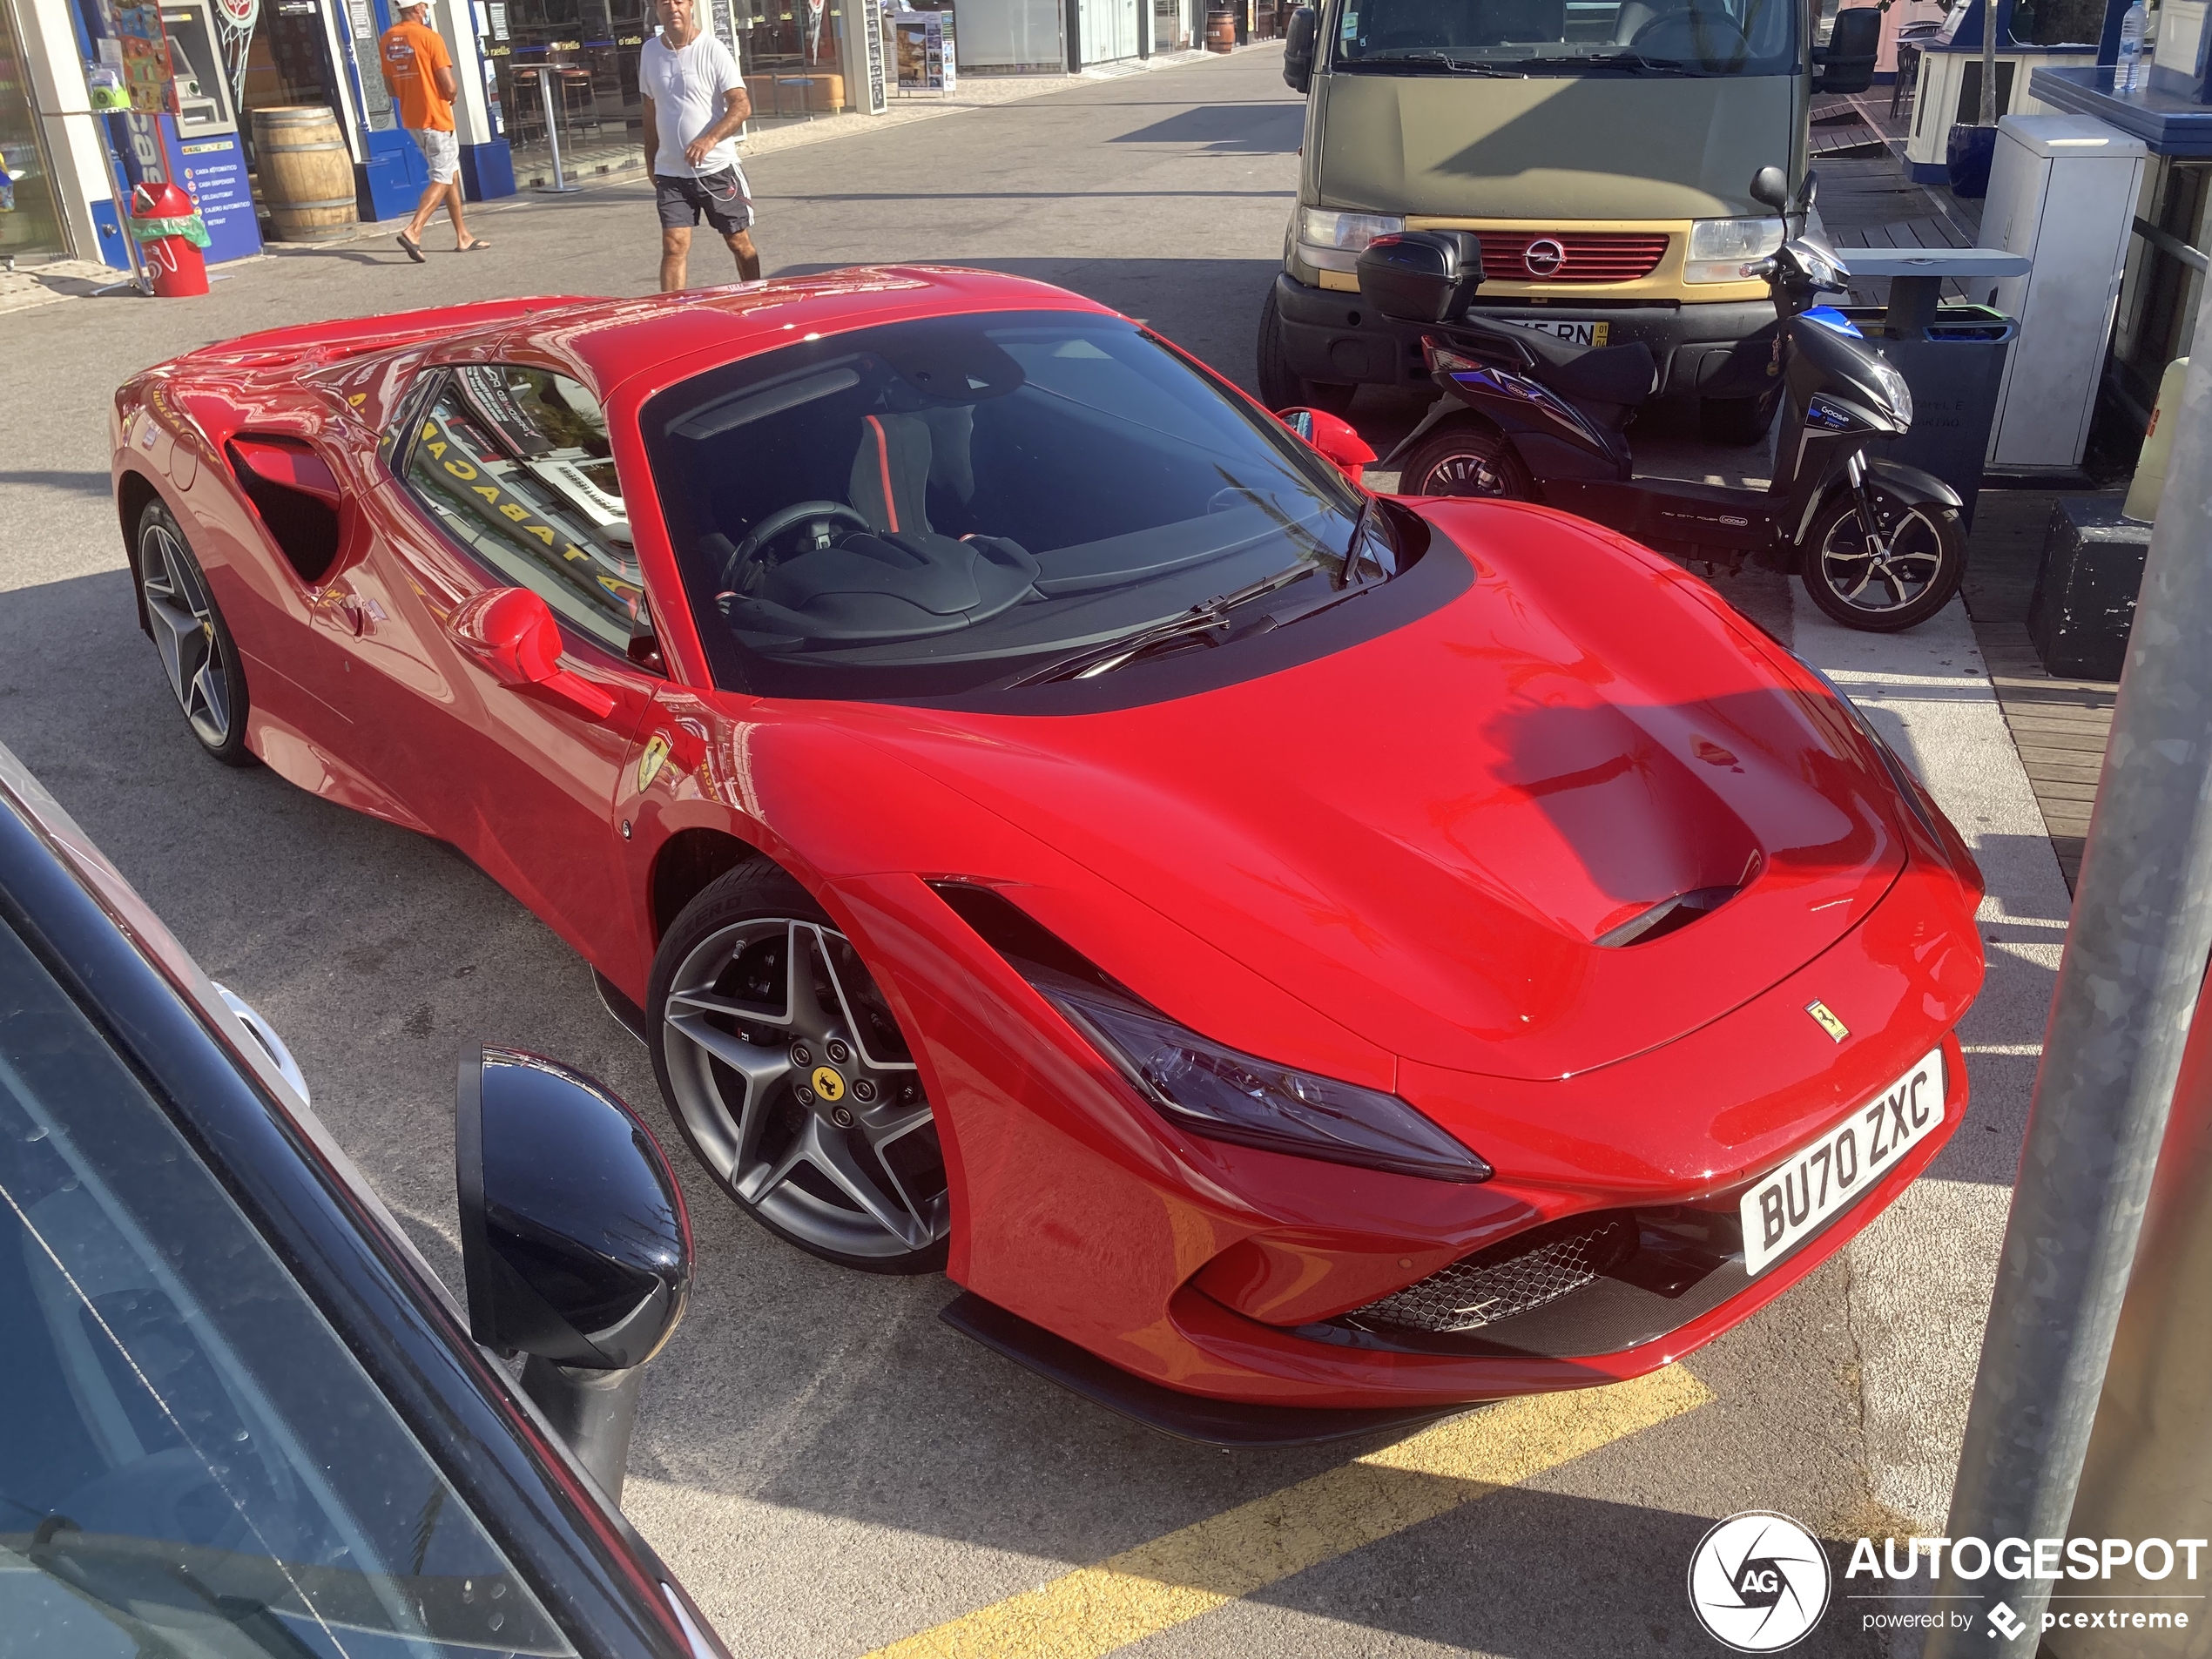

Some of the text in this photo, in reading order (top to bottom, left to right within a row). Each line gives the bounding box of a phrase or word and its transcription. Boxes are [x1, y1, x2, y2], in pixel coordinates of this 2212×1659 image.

[212, 177, 236, 186] DISPENSER
[205, 205, 223, 214] CAJERO
[207, 217, 226, 226] RETRAIT
[1599, 325, 1608, 334] 01
[1759, 1070, 1929, 1251] BU70 ZXC
